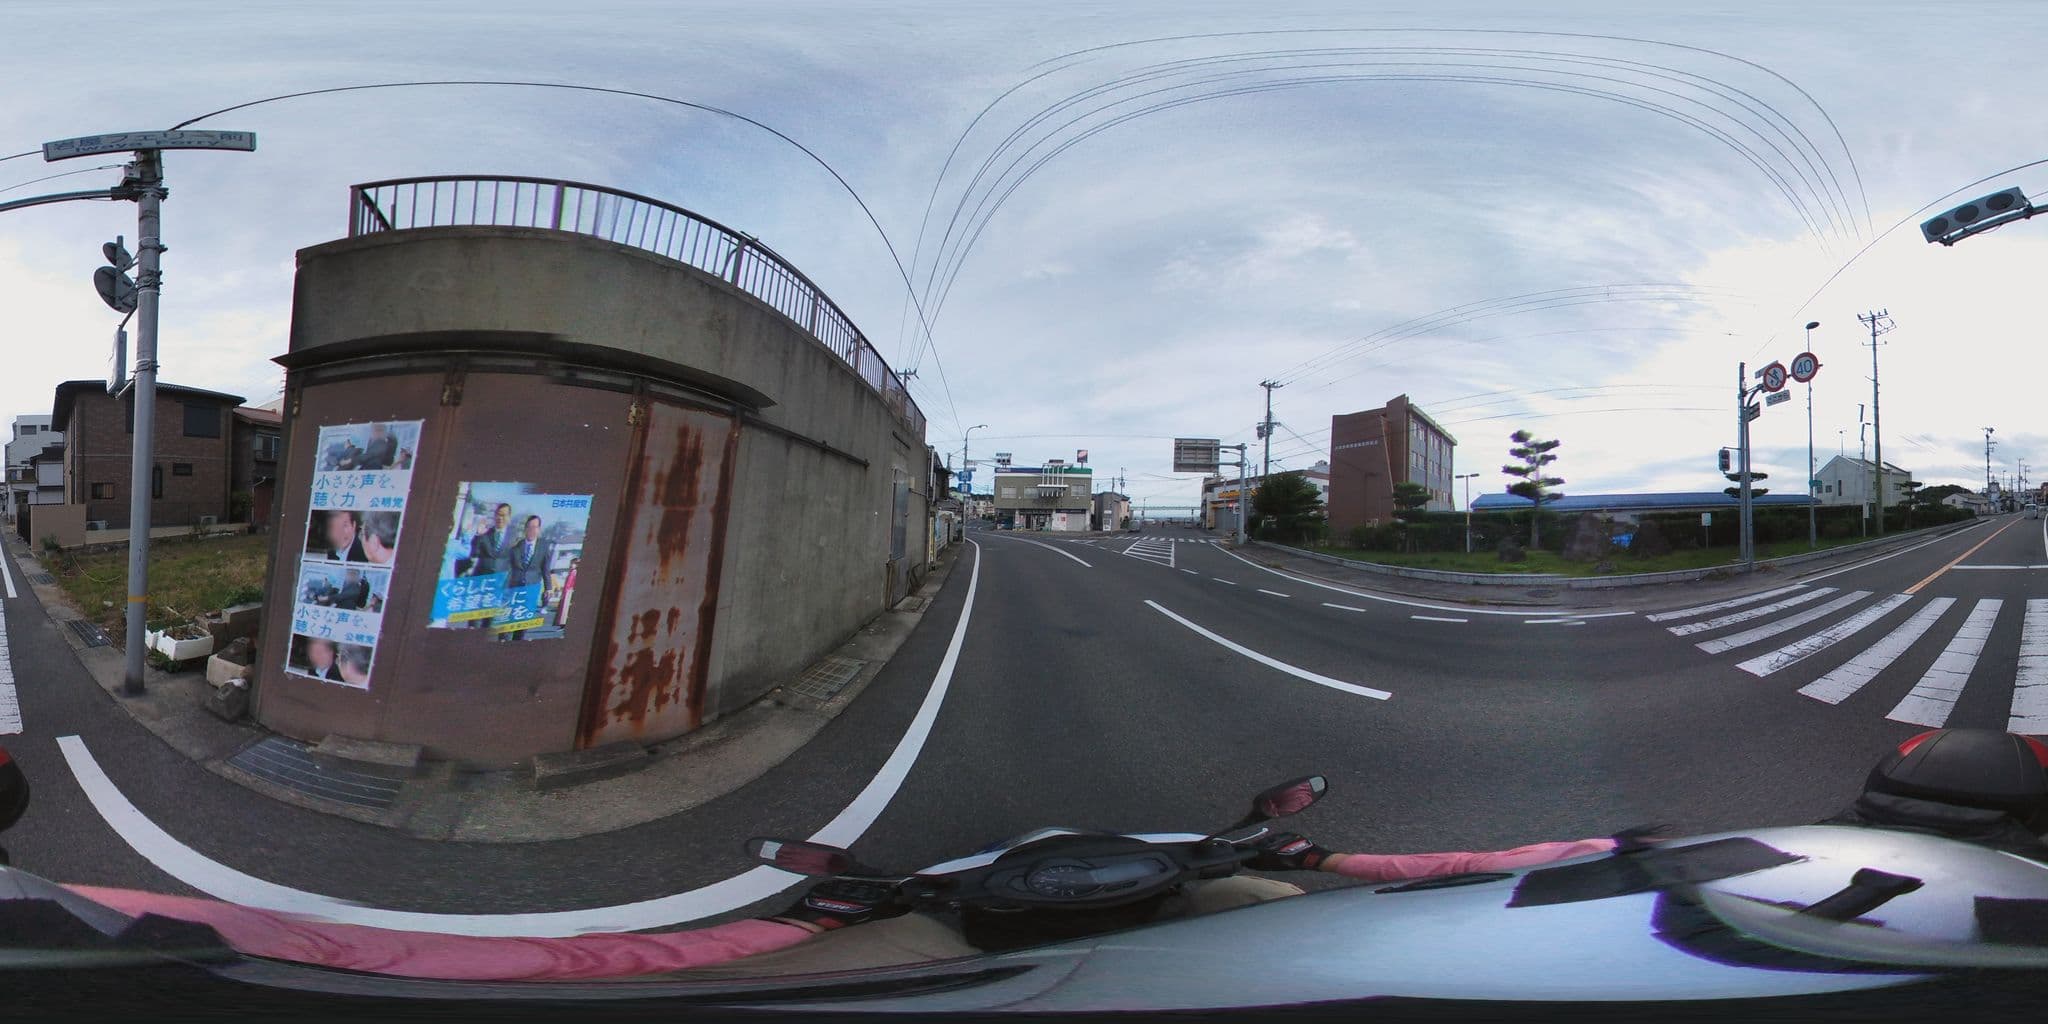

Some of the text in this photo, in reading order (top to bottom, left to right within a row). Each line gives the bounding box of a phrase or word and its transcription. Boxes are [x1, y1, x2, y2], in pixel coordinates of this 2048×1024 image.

[1797, 359, 1812, 374] 40
[316, 473, 395, 491] 小さな声を、
[369, 495, 404, 510] 公明党
[551, 498, 588, 509] 日本共産党
[440, 577, 497, 598] くらしに
[296, 607, 368, 629] 小さな声を、
